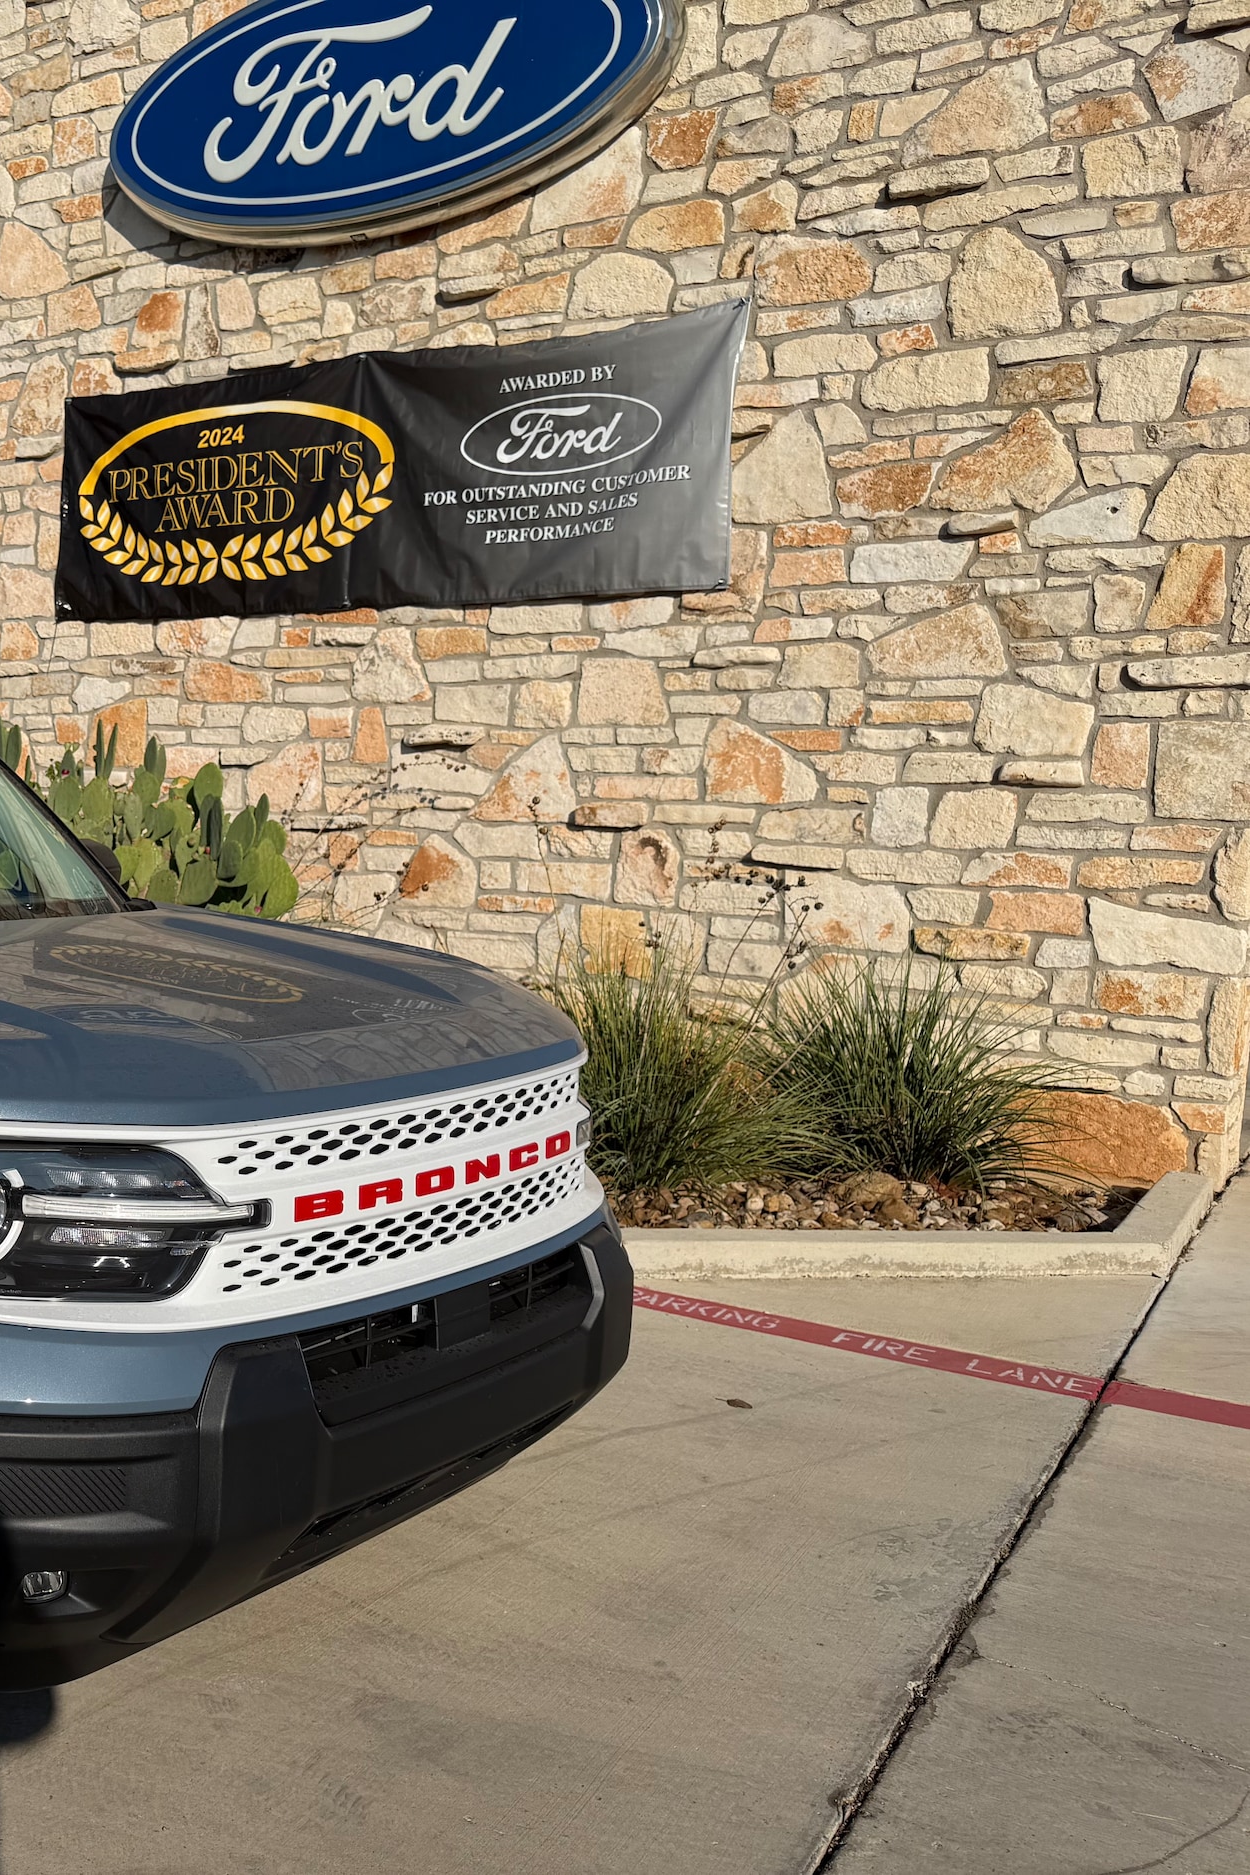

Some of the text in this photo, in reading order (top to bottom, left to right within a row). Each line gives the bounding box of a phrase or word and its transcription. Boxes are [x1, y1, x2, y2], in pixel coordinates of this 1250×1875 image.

[203, 3, 518, 184] Ford
[498, 364, 617, 394] AWARDED BY
[197, 424, 245, 449] 2024
[496, 404, 624, 464] Ford
[108, 440, 366, 504] PRESIDENT'S
[423, 464, 692, 507] FOR OUTSTANDING CUSTOMER
[154, 486, 296, 534] AWARD
[465, 492, 639, 525] SERVICE AND SALES
[484, 517, 616, 545] PERFORMANCE
[292, 1129, 573, 1224] BRONCO
[831, 1331, 937, 1363] FIRE
[964, 1358, 1099, 1395] LANE
